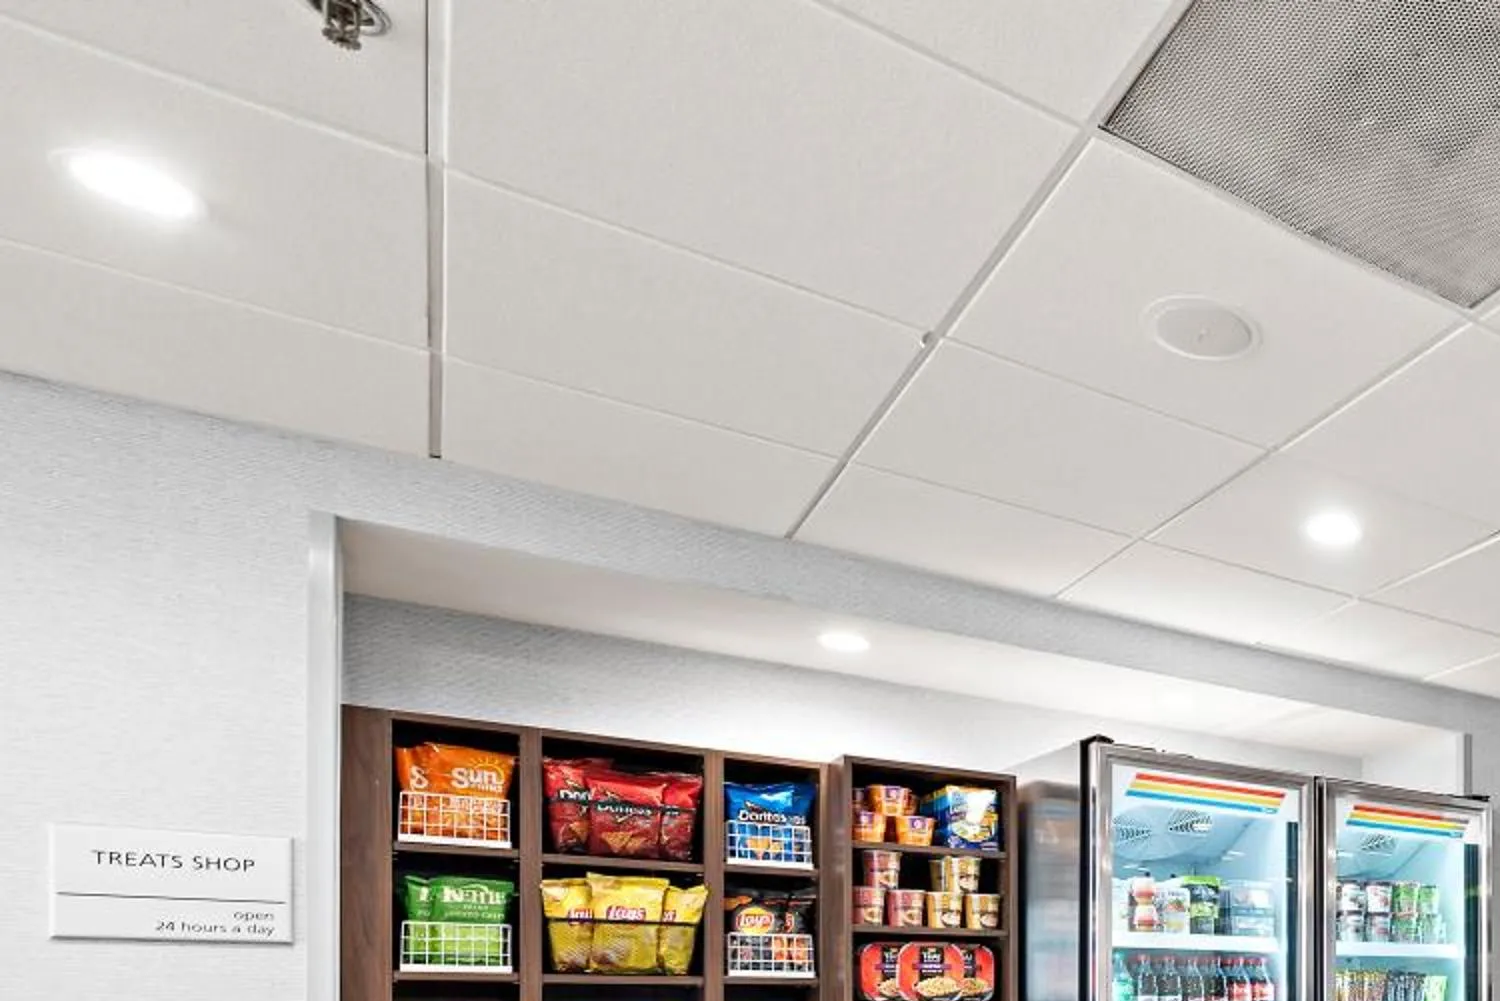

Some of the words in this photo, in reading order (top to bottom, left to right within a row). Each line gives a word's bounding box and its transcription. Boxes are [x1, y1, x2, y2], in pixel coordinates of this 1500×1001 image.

[451, 766, 498, 789] Sun
[738, 809, 788, 823] Doritos
[91, 849, 184, 869] TREATS
[192, 856, 256, 872] SHOP
[233, 911, 275, 922] open
[155, 921, 176, 932] 24
[181, 921, 227, 934] hours
[232, 926, 241, 934] a
[247, 924, 275, 937] day
